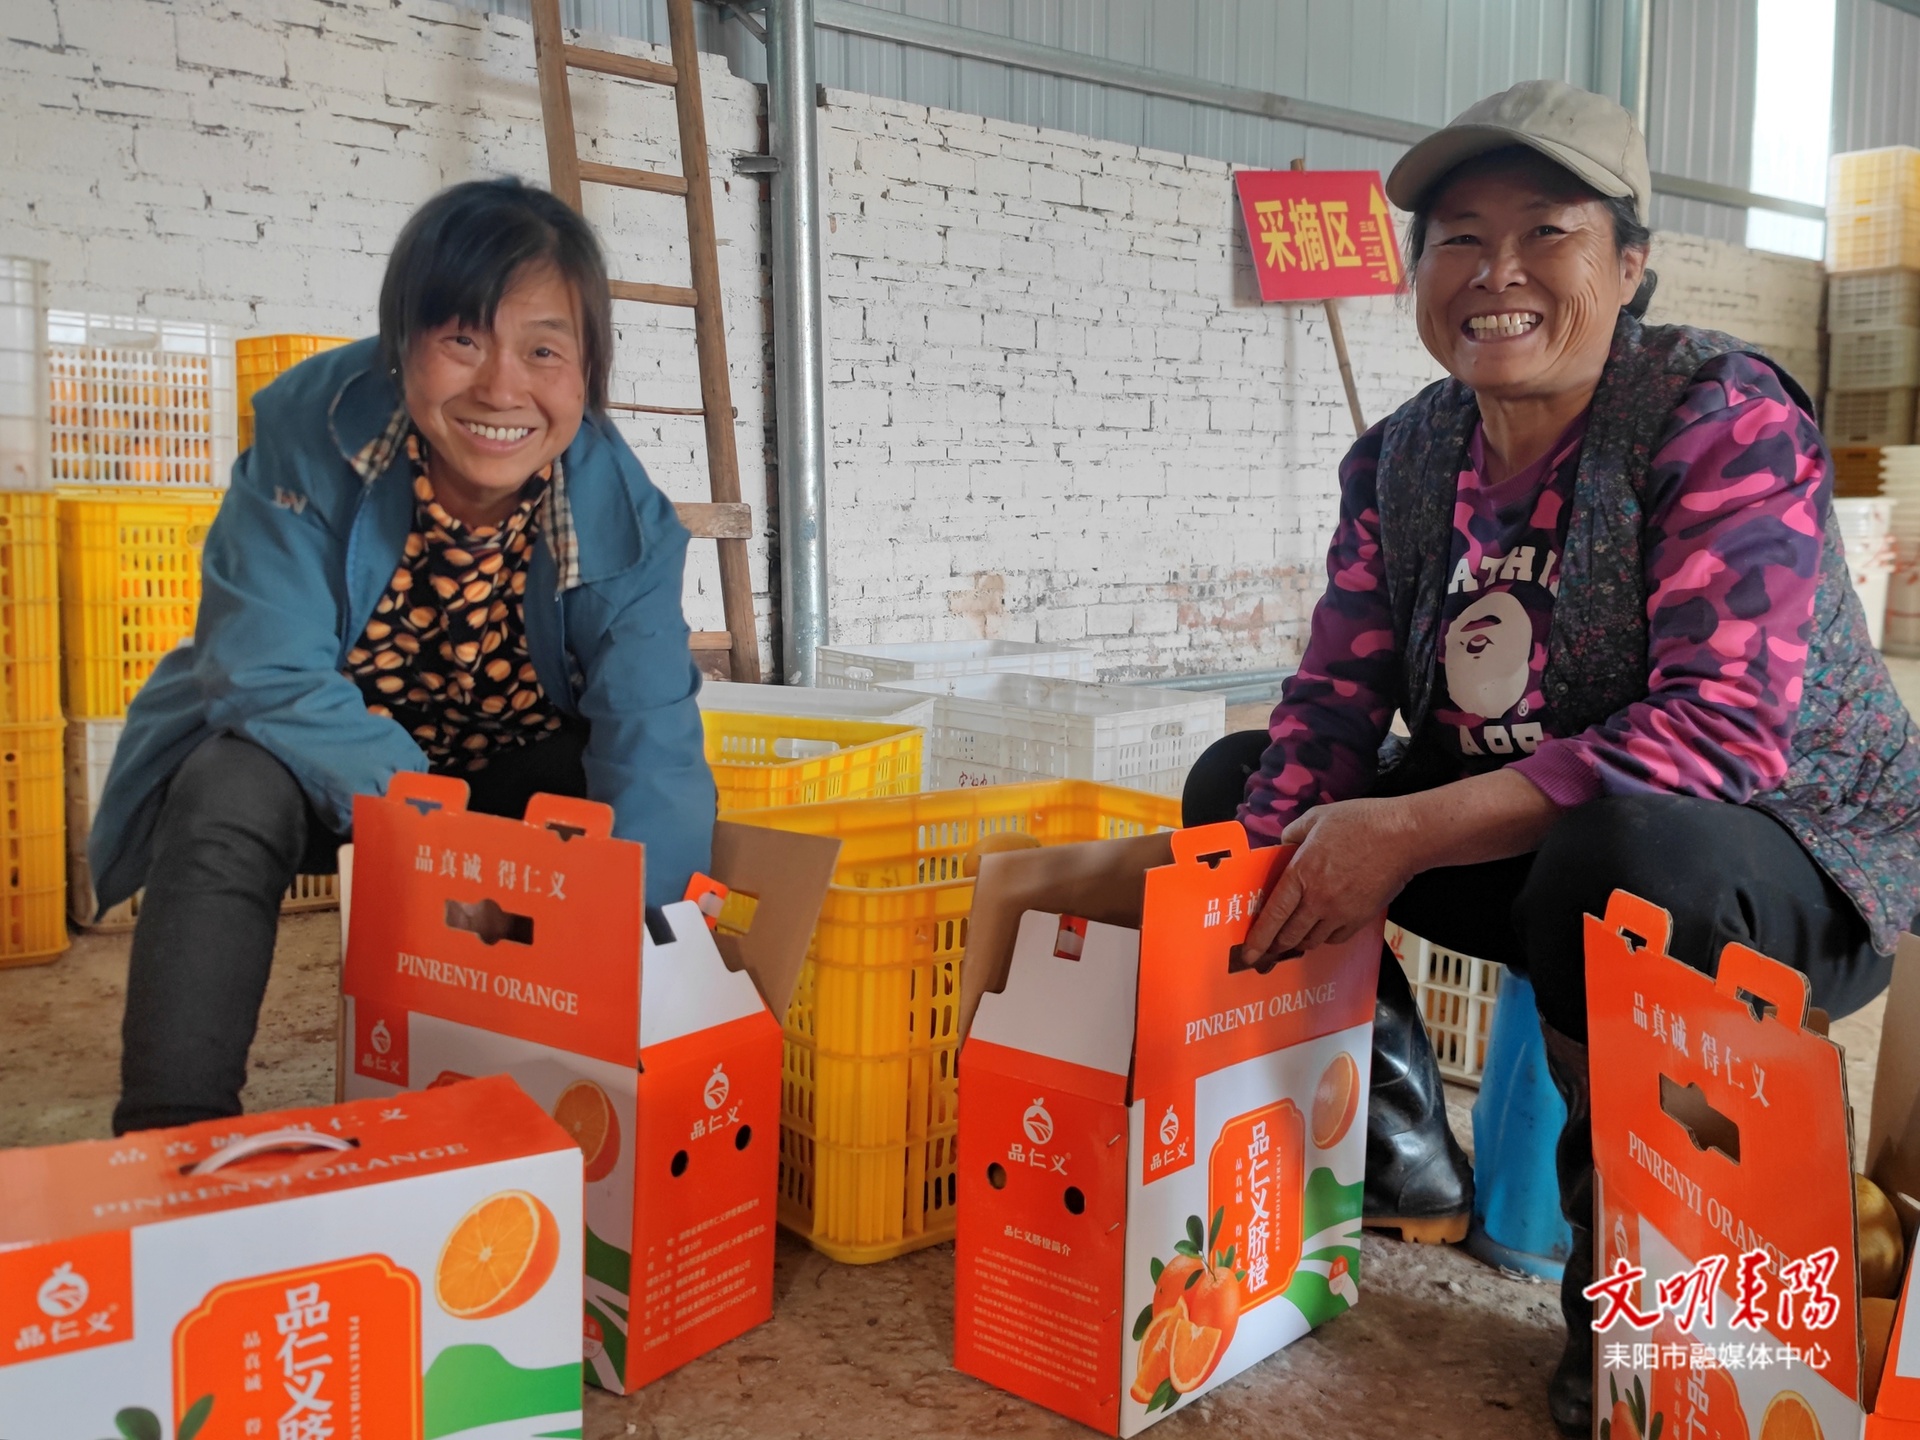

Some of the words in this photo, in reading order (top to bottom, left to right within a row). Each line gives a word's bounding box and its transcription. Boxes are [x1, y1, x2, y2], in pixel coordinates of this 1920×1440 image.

[1254, 197, 1363, 272] 采摘区
[415, 844, 482, 884] 品真诚
[498, 859, 567, 901] 得仁义
[396, 951, 488, 994] PINRENYI
[493, 973, 579, 1016] ORANGE
[1184, 1000, 1264, 1045] PINRENYI
[1268, 981, 1337, 1018] ORANGE
[1633, 991, 1690, 1058] 品真诚
[1701, 1031, 1771, 1108] 得仁义
[690, 1106, 740, 1141] 品仁义
[93, 1173, 292, 1217] PINRENYI
[306, 1142, 469, 1181] ORANGE
[1007, 1142, 1068, 1176] 品仁义
[1150, 1142, 1188, 1172] 品仁义
[1628, 1130, 1702, 1216] PINRENYI
[1247, 1120, 1271, 1294] 品仁义脐橙
[14, 1310, 114, 1351] 品仁义
